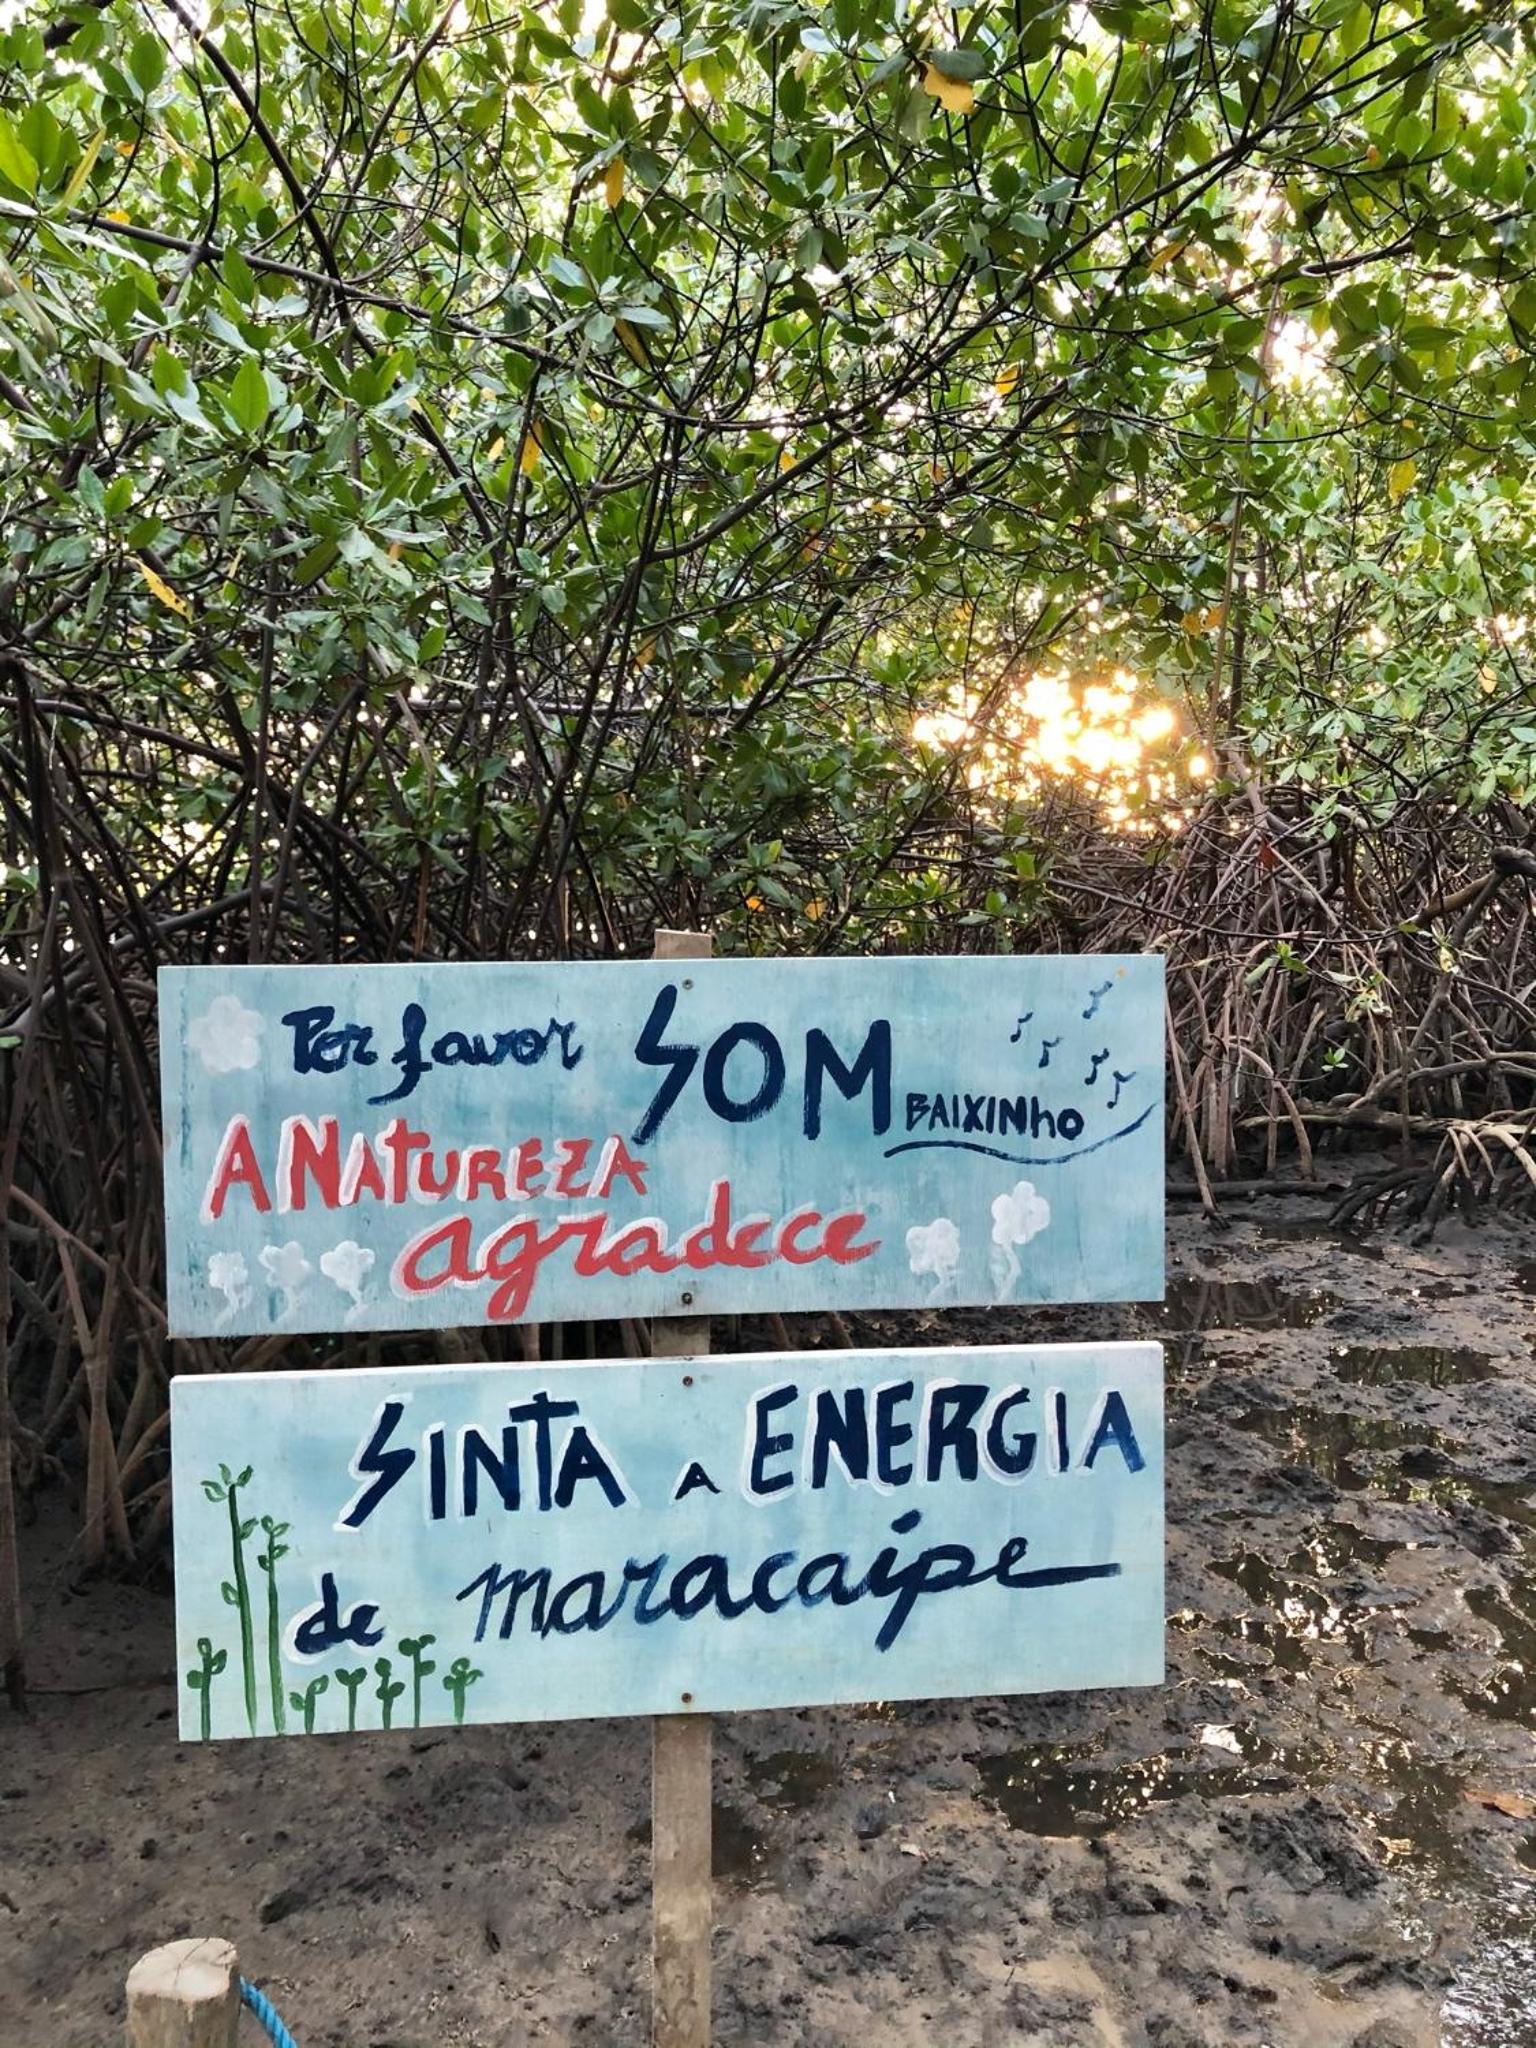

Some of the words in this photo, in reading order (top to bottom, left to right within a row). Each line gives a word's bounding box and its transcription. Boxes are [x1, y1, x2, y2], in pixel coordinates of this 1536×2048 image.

[281, 1004, 378, 1074] Por
[368, 1003, 585, 1105] favor
[630, 983, 892, 1146] SOM
[203, 1116, 272, 1223] A
[393, 1177, 882, 1320] agradece
[336, 1391, 634, 1530] SINTA
[672, 1462, 722, 1504] A
[745, 1379, 1146, 1502] ENERGIA
[290, 1569, 388, 1660] de
